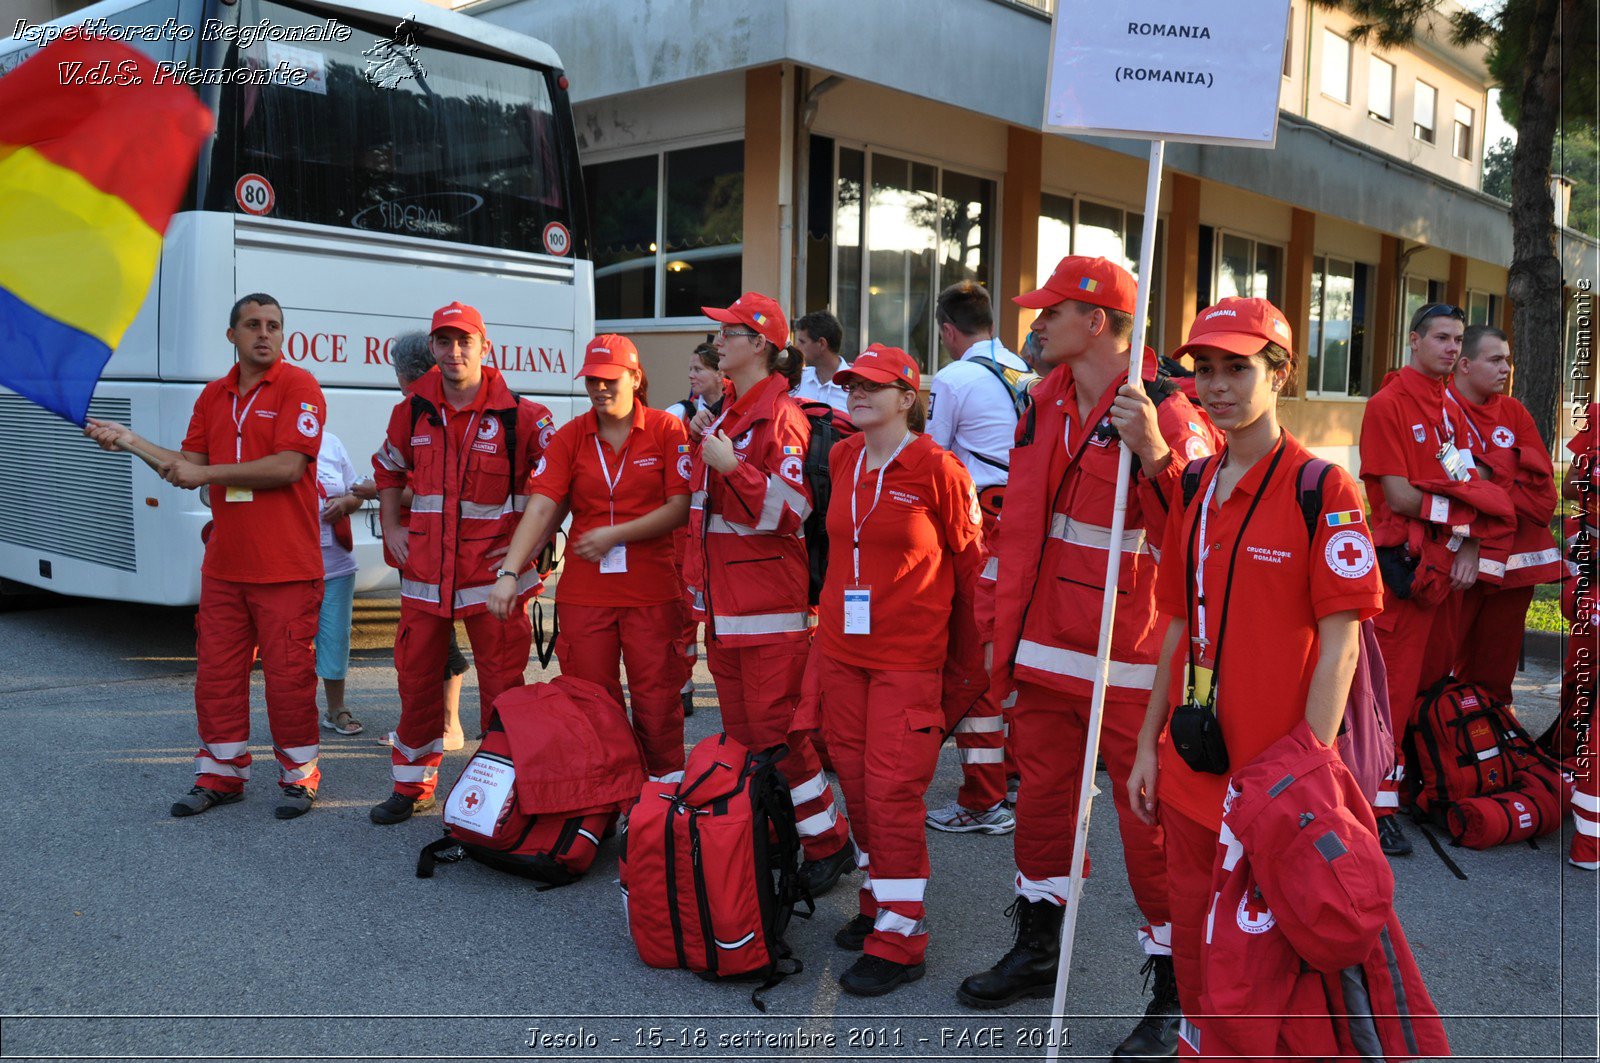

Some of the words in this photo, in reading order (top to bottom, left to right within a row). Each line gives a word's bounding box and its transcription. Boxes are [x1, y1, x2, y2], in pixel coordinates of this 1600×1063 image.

[1127, 22, 1211, 39] ROMANIA
[1115, 67, 1214, 89] (ROMANIA)
[244, 184, 266, 204] 80
[380, 201, 446, 234] SIDERAL
[549, 233, 565, 247] 100
[1205, 309, 1236, 320] ROMANIA
[282, 331, 348, 363] OCE
[364, 336, 397, 365] RO
[486, 345, 567, 374] ALIANA
[472, 442, 495, 451] OLUNTAR
[1247, 546, 1271, 555] CRUCEA
